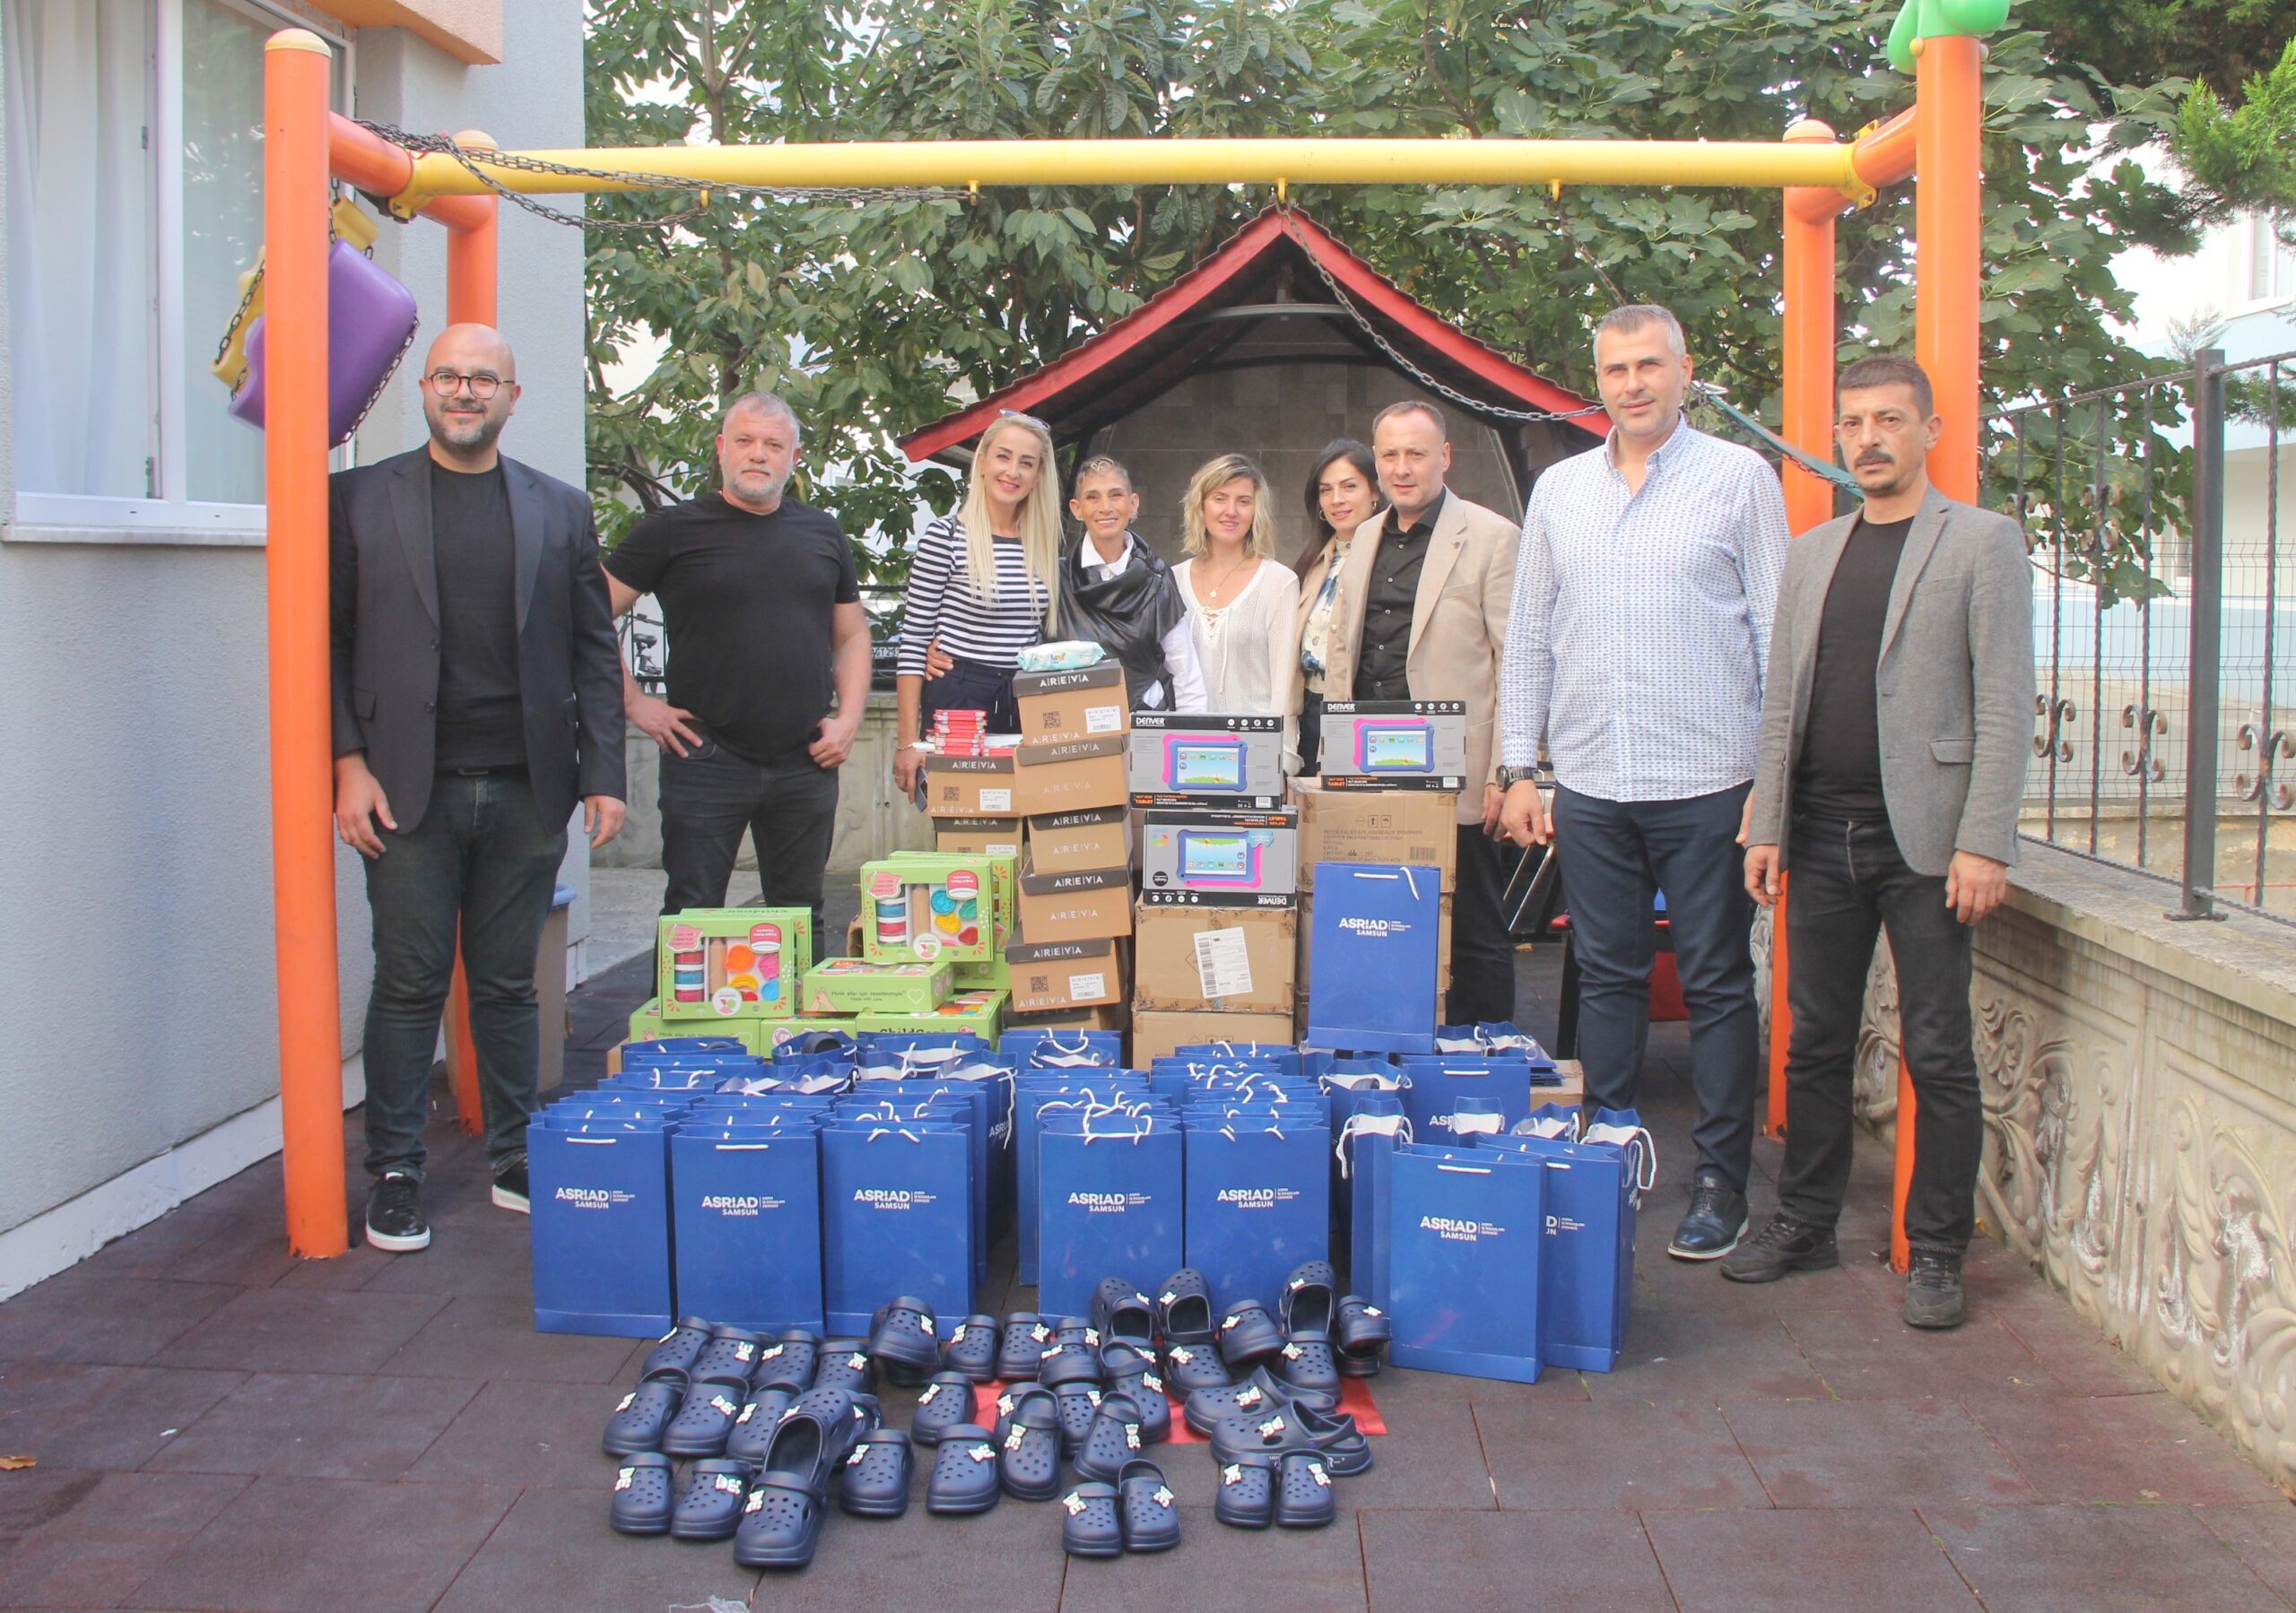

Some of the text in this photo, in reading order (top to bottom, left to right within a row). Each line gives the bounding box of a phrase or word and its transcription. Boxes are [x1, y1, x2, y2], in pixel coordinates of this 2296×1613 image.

[1327, 703, 1355, 711] DENVER
[1135, 717, 1165, 725] DENVER
[1258, 896, 1287, 905] DENVER
[1356, 929, 1387, 937] SAMSUN
[575, 1200, 609, 1210] SAMSUN
[874, 1201, 909, 1210] SAMSUN
[722, 1208, 758, 1216] SAMSUN
[1439, 1231, 1476, 1241] SAMSUN
